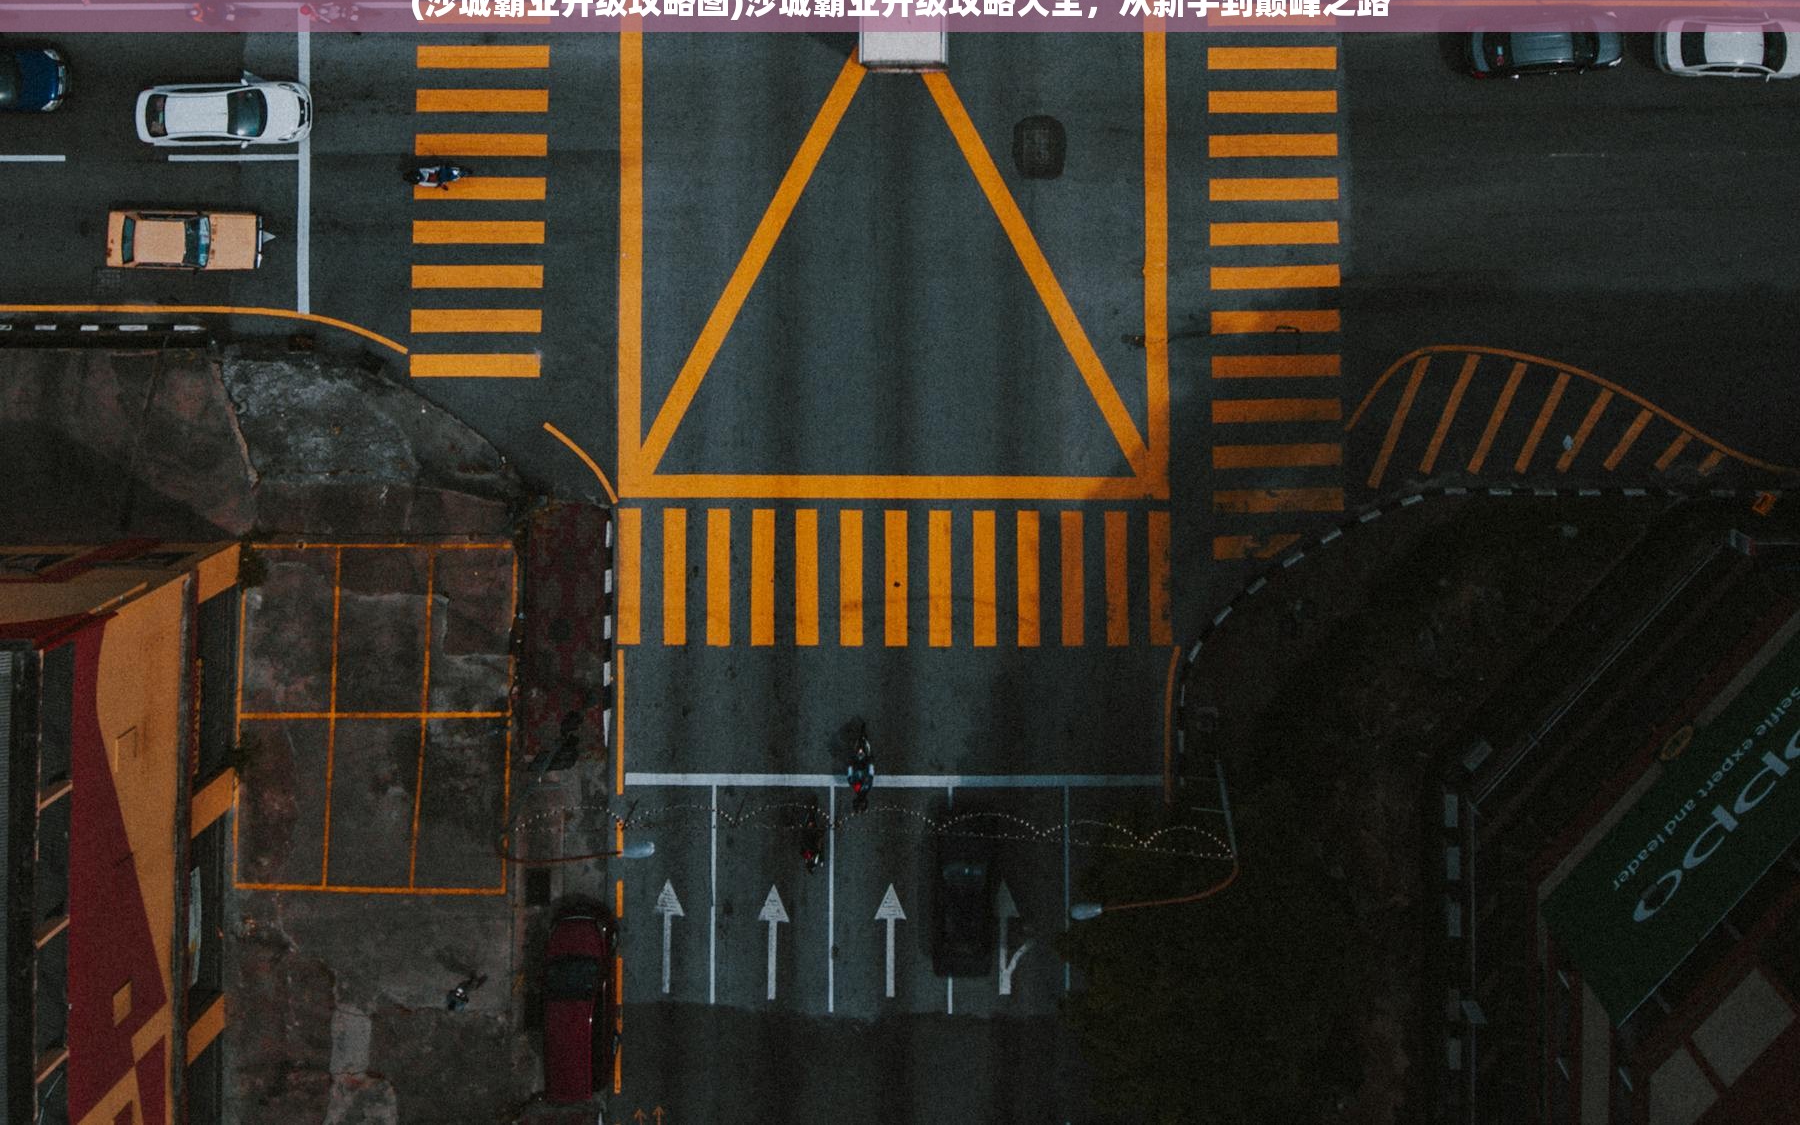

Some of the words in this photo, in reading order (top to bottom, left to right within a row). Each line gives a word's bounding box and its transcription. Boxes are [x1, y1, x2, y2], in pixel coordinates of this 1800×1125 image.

[1697, 738, 1754, 798] expert
[1664, 798, 1698, 836] and
[1613, 833, 1666, 891] leader
